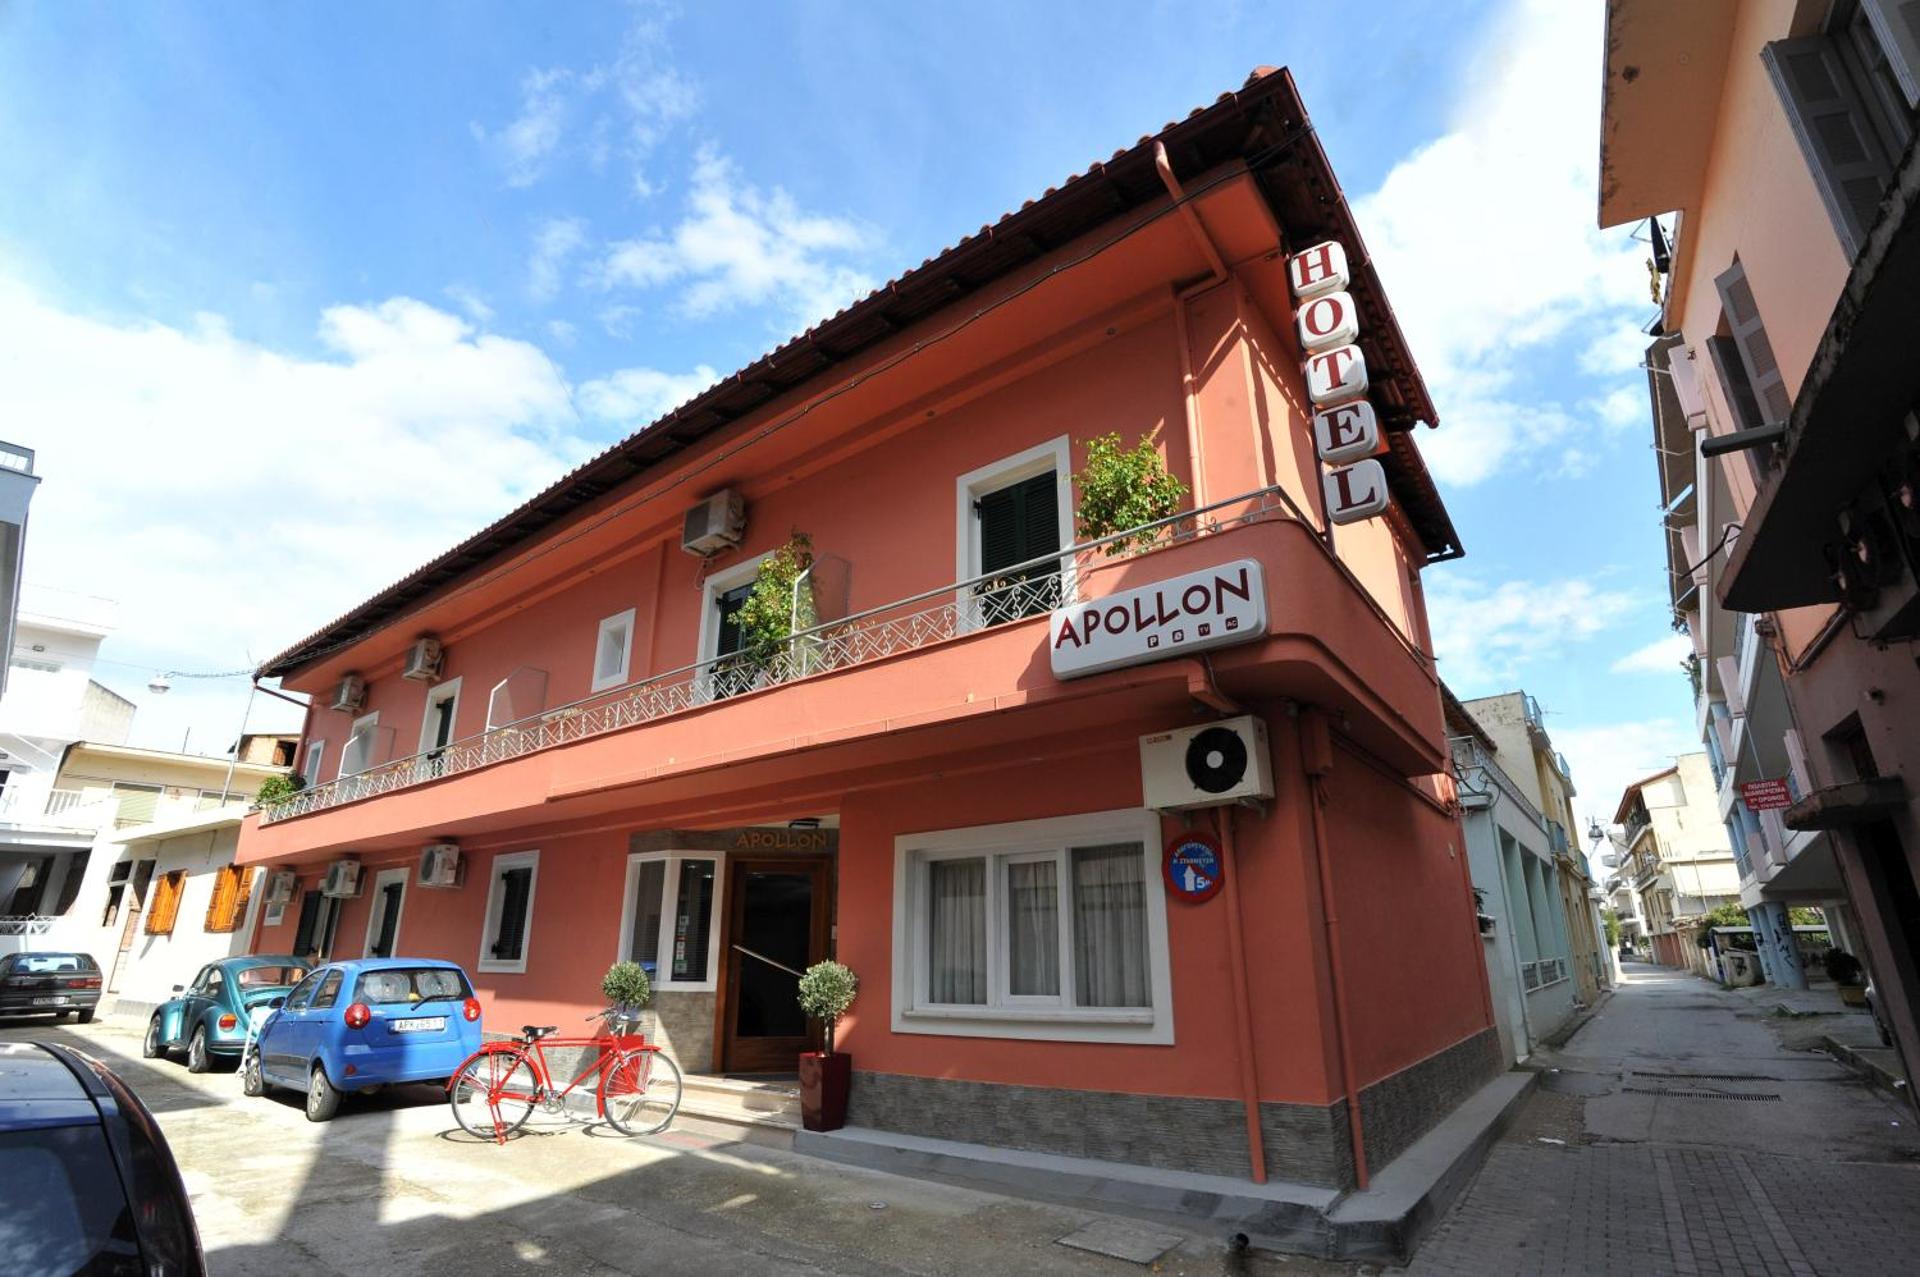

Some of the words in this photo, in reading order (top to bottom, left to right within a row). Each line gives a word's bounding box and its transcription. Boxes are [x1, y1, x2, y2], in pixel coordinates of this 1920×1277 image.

[1295, 243, 1376, 512] HOTEL
[1054, 567, 1250, 649] APOLLON
[1199, 624, 1210, 635] TV
[736, 831, 827, 849] APOLLON
